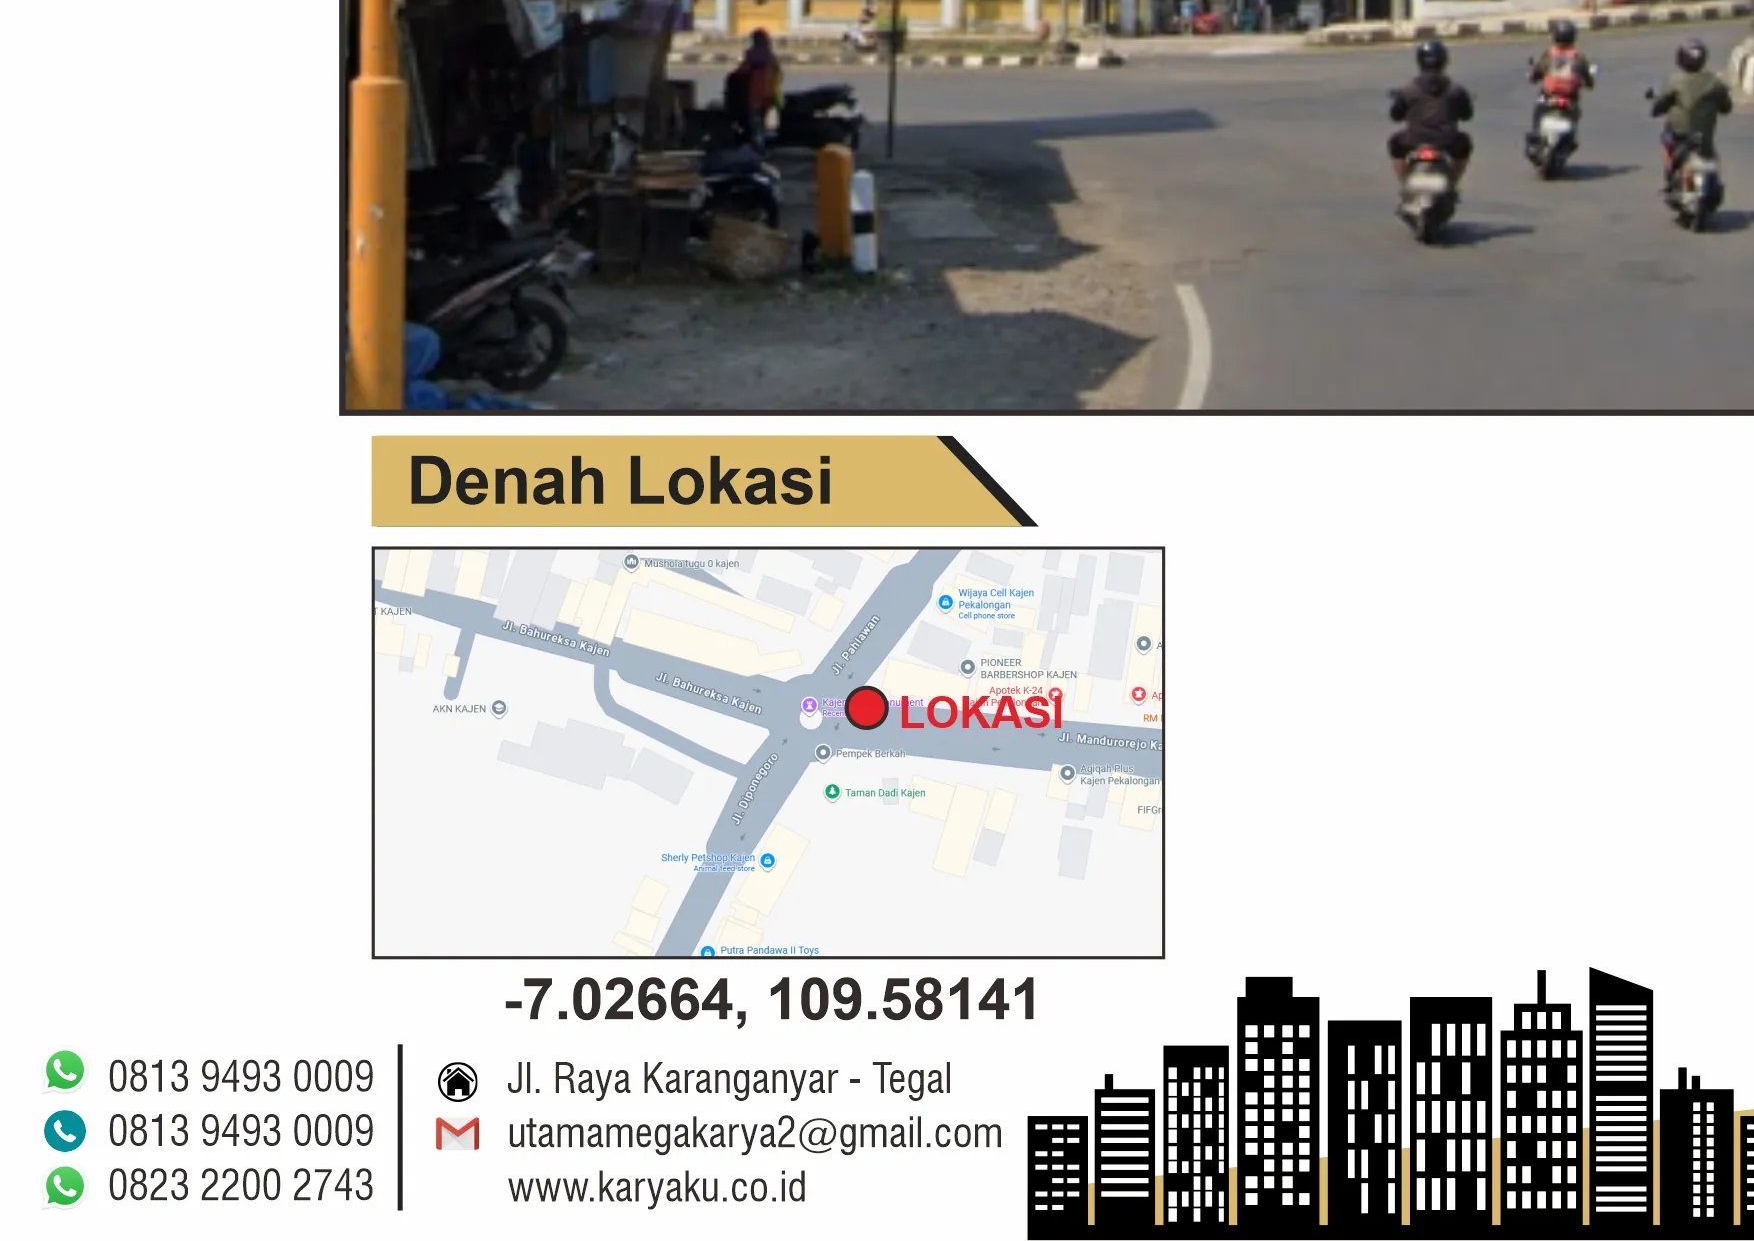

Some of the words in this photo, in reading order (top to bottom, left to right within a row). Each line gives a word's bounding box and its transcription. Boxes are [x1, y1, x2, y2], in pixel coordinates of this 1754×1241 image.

[645, 559, 683, 568] Mushola
[685, 559, 705, 569] tugu
[716, 559, 740, 570] kajen
[958, 588, 988, 599] Wijaya
[990, 588, 1007, 597] Cell
[1009, 588, 1035, 599] Kajen
[958, 600, 1011, 611] Pekalongan
[380, 607, 412, 616] KAJEN
[973, 612, 995, 620] phone
[502, 620, 516, 632] Jl.
[519, 624, 577, 648] Bahureksa
[579, 640, 610, 657] Kajen
[832, 662, 846, 676] Jl.
[841, 615, 880, 662] Pahlawan
[980, 658, 1021, 667] PIONEER
[980, 670, 1044, 679] BARBERSHOP
[1046, 670, 1077, 679] KAJEN
[656, 672, 670, 684] Jl.
[672, 677, 729, 704] Bahureksa
[731, 697, 762, 715] Kajen
[989, 686, 1021, 696] Apotek
[1023, 686, 1043, 695] K-24
[432, 705, 453, 713] AKN
[455, 705, 487, 713] KAJEN
[1143, 714, 1158, 722] RM
[1059, 732, 1073, 743] Jl.
[1076, 733, 1147, 751] Mandurorejo
[836, 749, 873, 760] Pempek
[875, 749, 906, 758] Berkah
[1080, 764, 1112, 775] Aqiqah
[1114, 764, 1134, 773] Plus
[1080, 777, 1106, 787] Kajen
[1107, 777, 1160, 787] Pekalongan
[731, 812, 745, 826] Jl.
[738, 753, 778, 809] Diponegoro
[845, 788, 876, 797] Taman
[878, 788, 899, 797] Dadi
[901, 788, 926, 799] Kajen
[661, 853, 689, 864] Sherly
[691, 853, 729, 863] Petshop
[730, 853, 756, 863] Kajen
[720, 946, 744, 955] Putra
[747, 946, 788, 955] Pandawa
[798, 946, 820, 957] Toys
